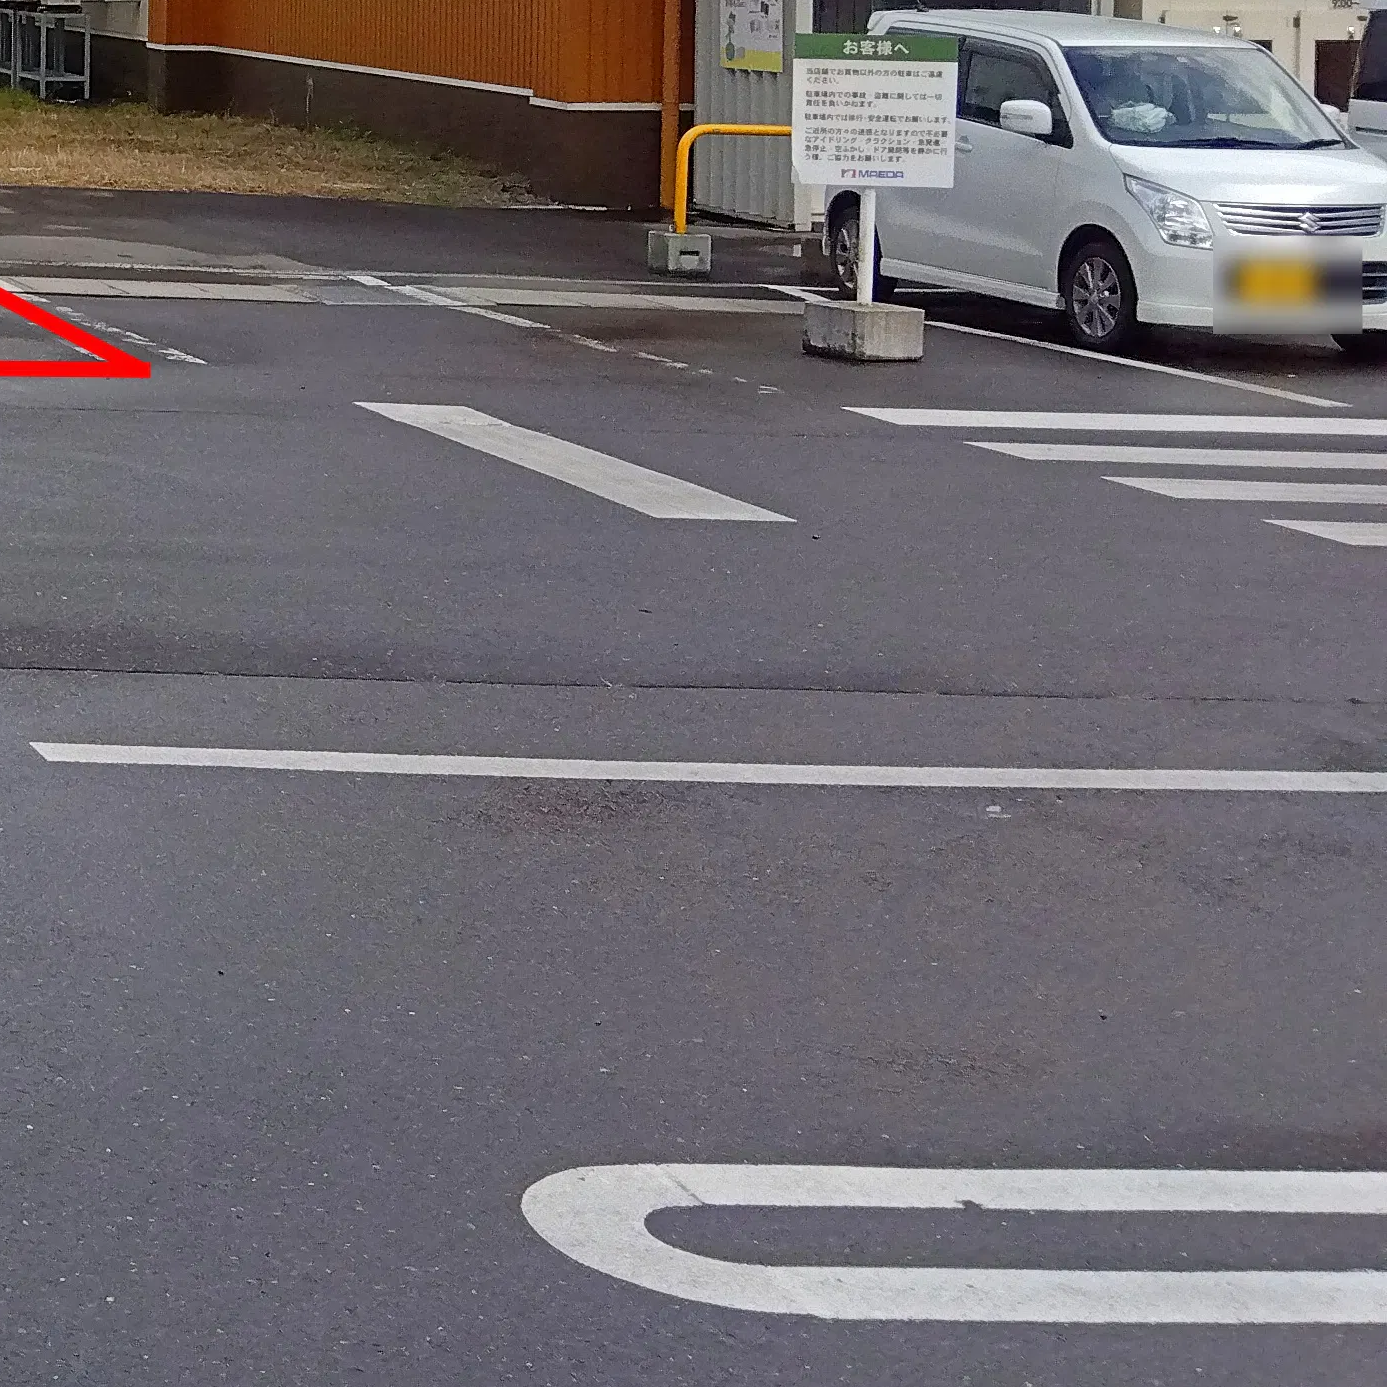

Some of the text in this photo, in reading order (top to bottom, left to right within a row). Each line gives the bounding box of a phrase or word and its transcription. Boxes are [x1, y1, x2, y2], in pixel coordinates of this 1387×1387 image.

[843, 39, 910, 55] お客様へ
[858, 169, 905, 179] MAEDA
